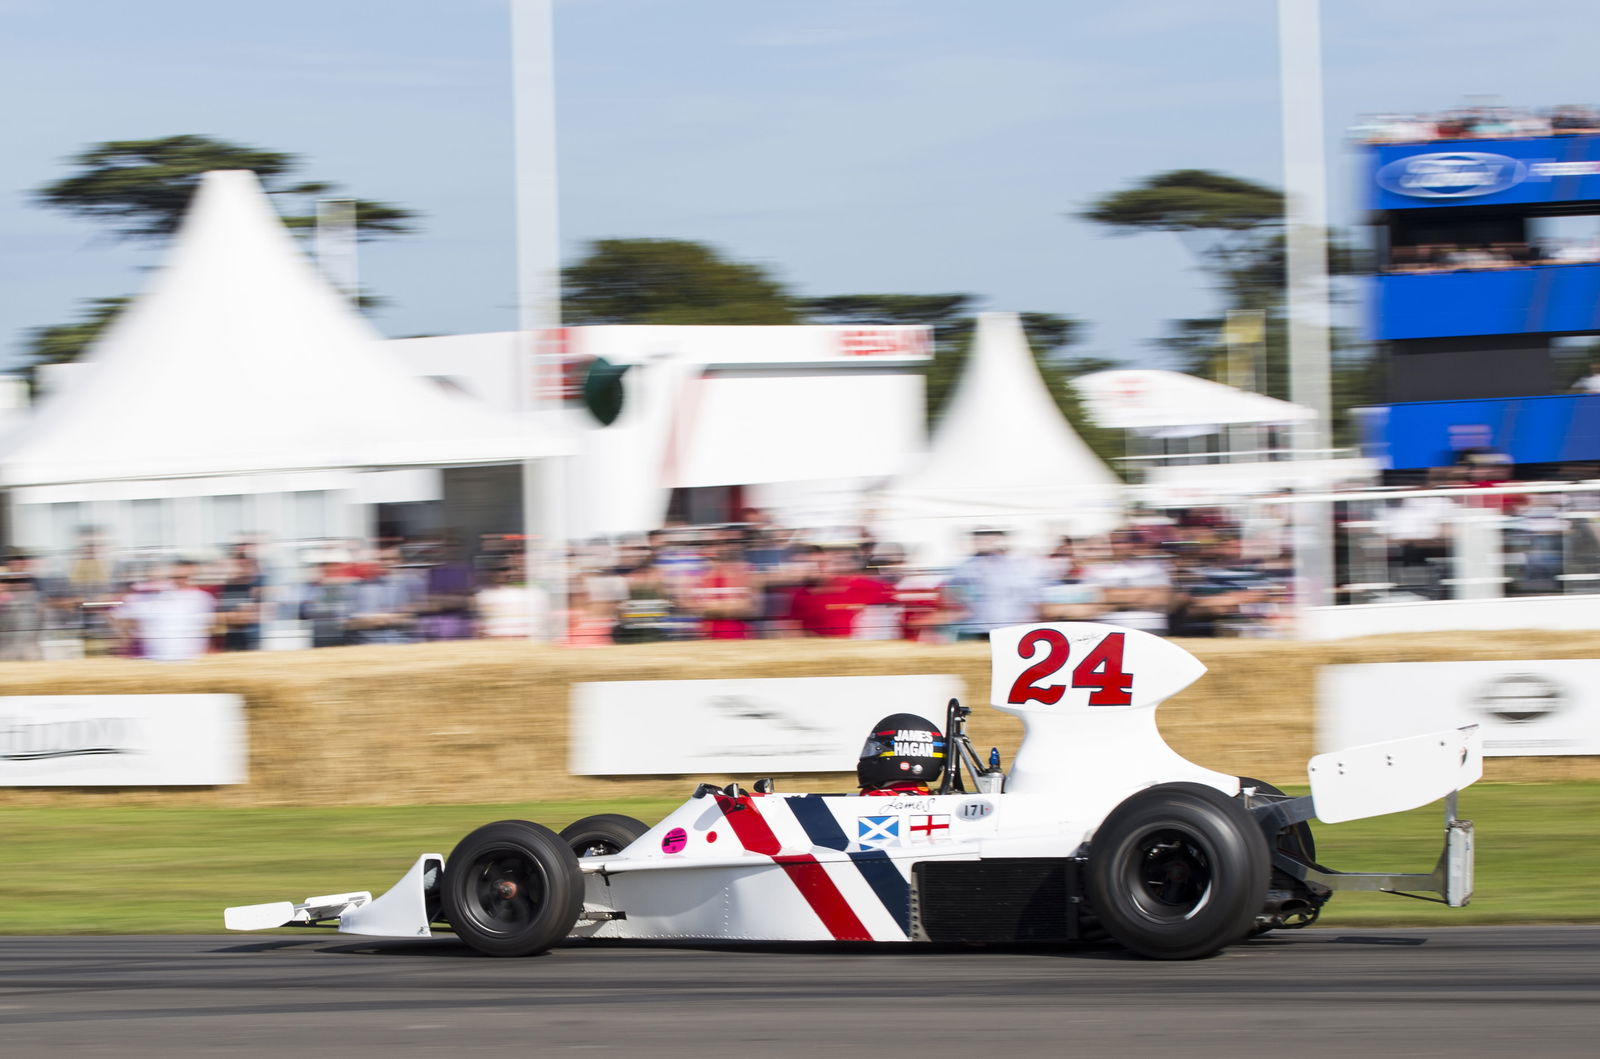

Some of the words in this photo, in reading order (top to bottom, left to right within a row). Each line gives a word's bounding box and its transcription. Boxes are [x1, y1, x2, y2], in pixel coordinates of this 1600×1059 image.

[1007, 628, 1134, 706] 24
[894, 729, 934, 742] JAMES
[893, 742, 934, 757] HAGAN
[964, 804, 985, 817] 171
